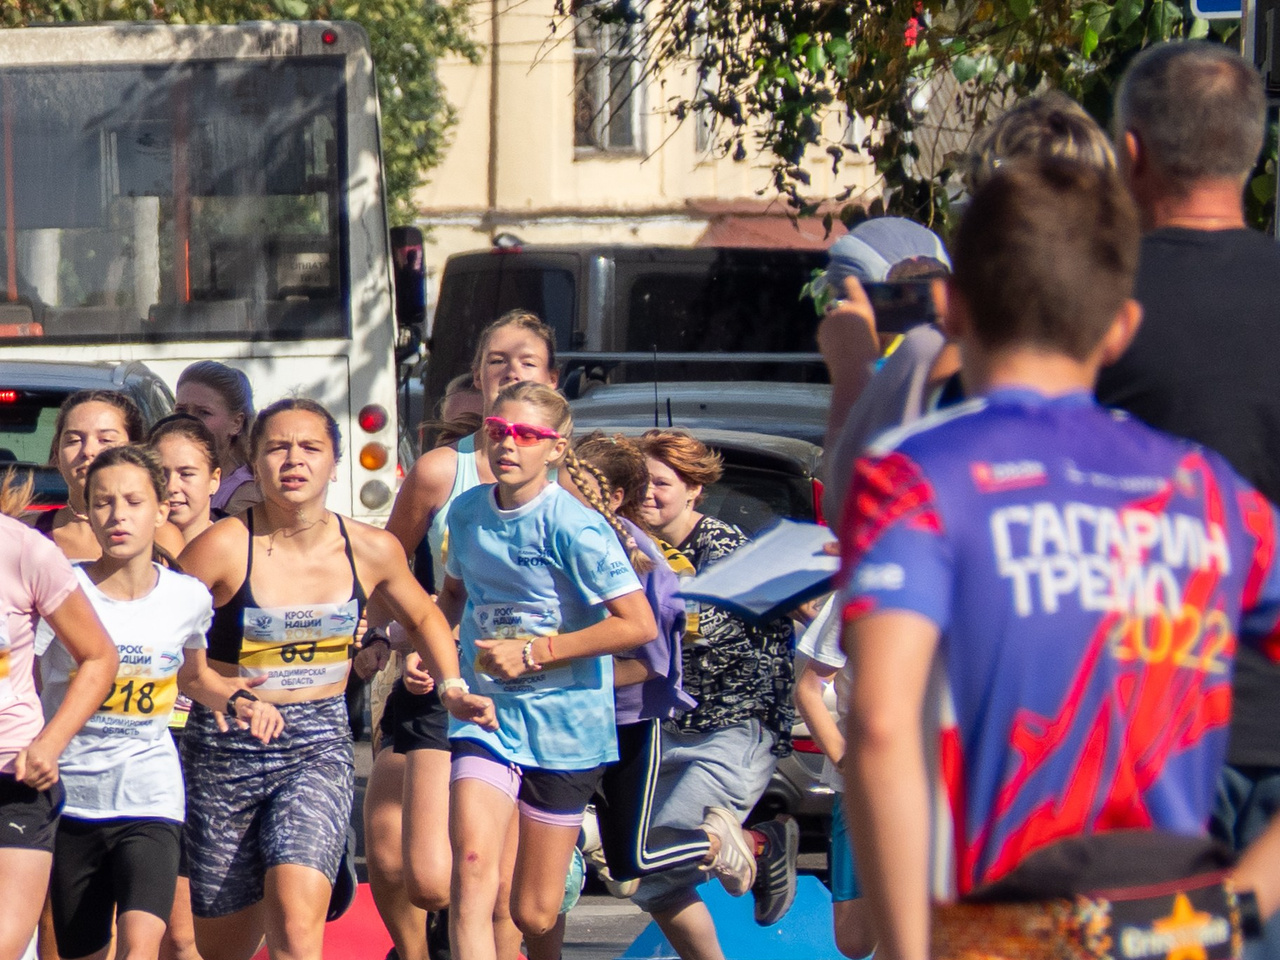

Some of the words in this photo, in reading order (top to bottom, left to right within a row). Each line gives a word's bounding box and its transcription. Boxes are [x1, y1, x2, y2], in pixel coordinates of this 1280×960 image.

[990, 501, 1231, 577] ГАГАРИН
[285, 610, 314, 619] КРОСС
[285, 619, 322, 629] НАЦИИ
[120, 655, 152, 664] АЦИИ
[122, 665, 152, 676] 024
[268, 668, 327, 679] ВЛАДИМИРСКАЯ
[281, 677, 314, 686] ОБЛАСТЬ
[99, 680, 155, 714] 218
[102, 726, 140, 735] ОБЛАСТЬ
